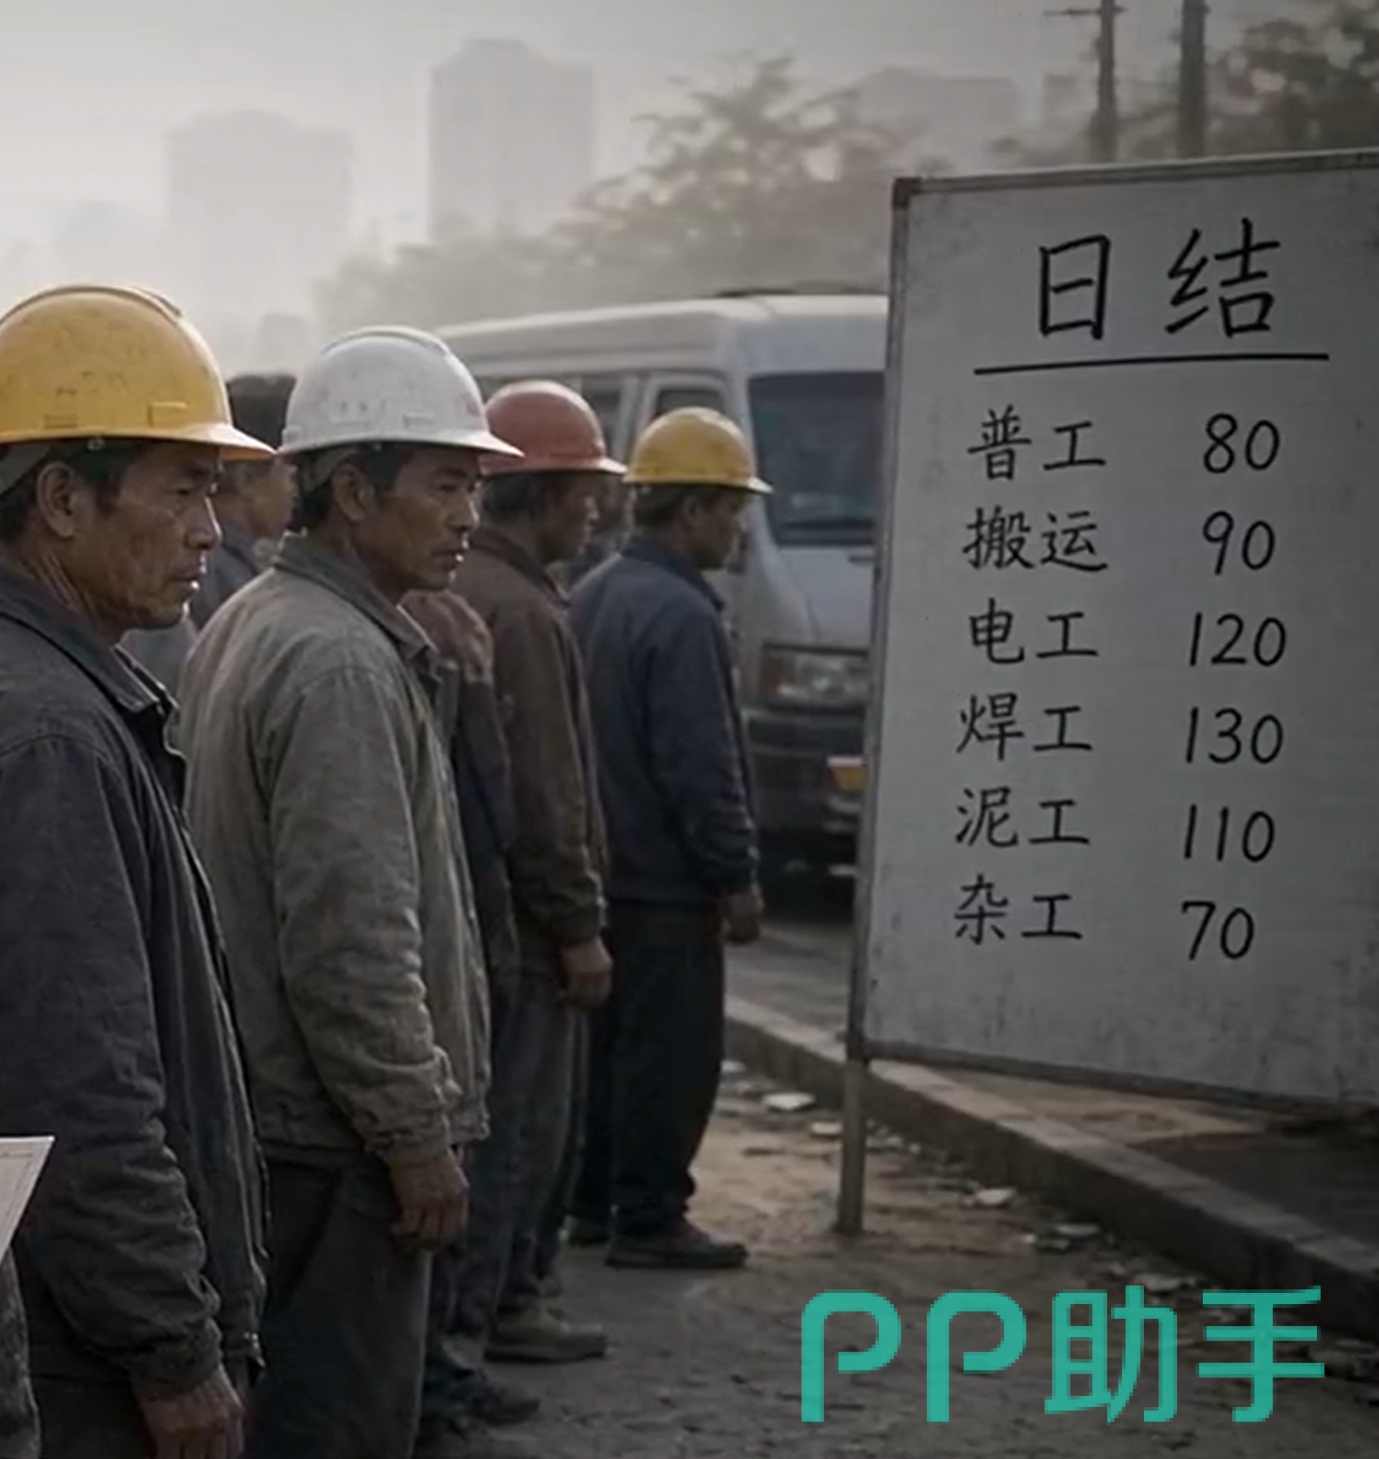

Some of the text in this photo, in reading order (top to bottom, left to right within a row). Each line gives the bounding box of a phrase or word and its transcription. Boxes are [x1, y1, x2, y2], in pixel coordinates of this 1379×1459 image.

[1038, 216, 1282, 341] 日结
[966, 403, 1281, 481] 普工 80
[962, 504, 1276, 576] 搬运 90
[968, 597, 1287, 668] 电工 120
[956, 692, 1284, 765] 焊工 130
[955, 786, 1276, 863] 泥工 110
[953, 873, 1255, 961] 杂工 70
